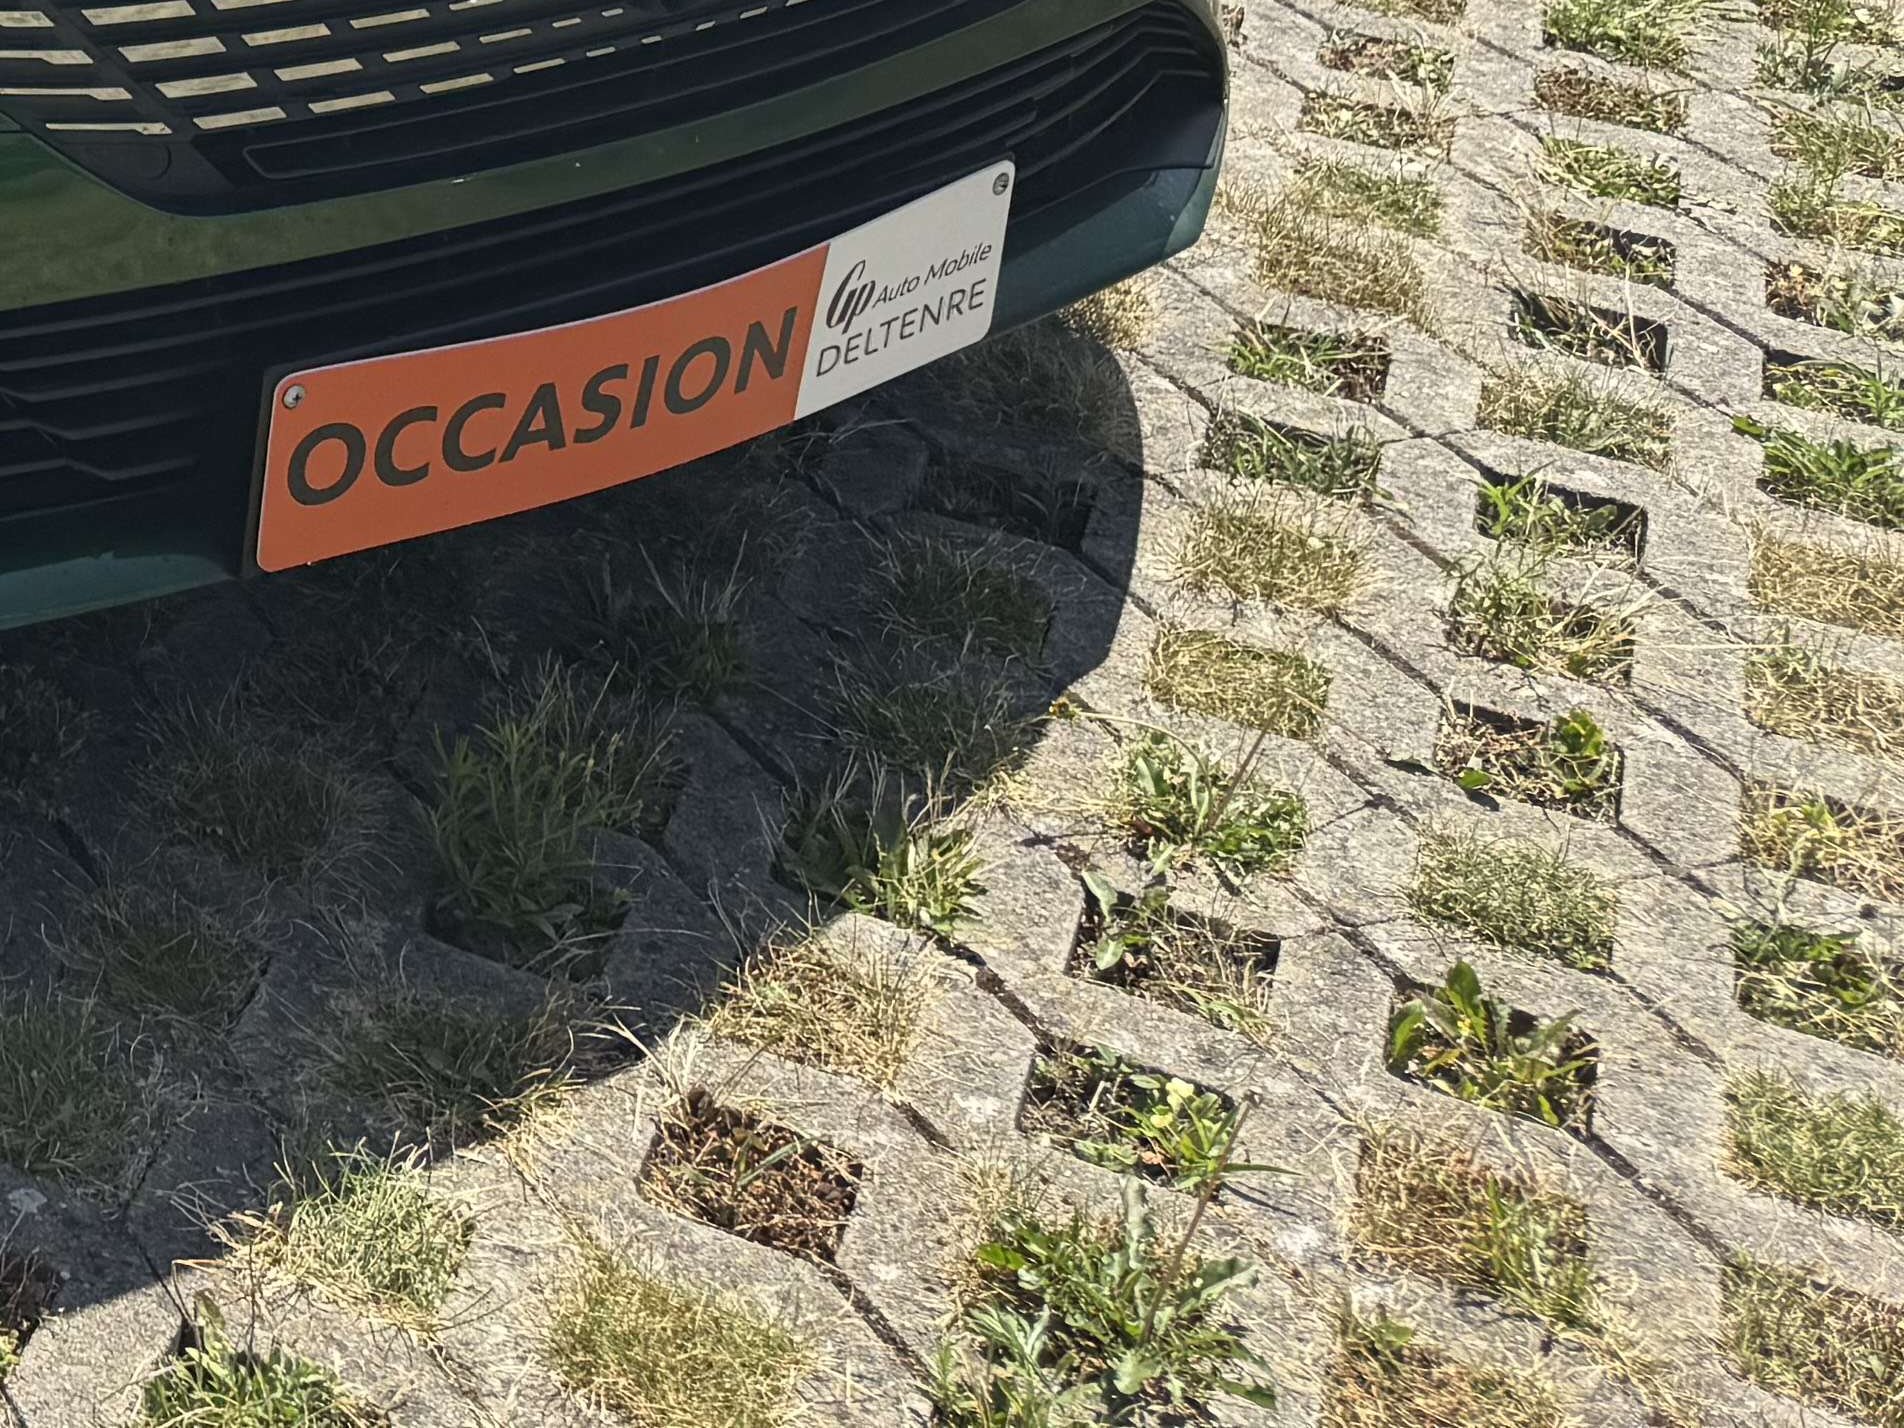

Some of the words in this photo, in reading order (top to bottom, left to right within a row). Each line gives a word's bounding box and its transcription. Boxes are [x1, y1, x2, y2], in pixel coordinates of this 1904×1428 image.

[872, 274, 920, 309] Auto
[923, 242, 992, 285] Mobile
[815, 278, 987, 377] DELTENRE
[286, 305, 799, 507] OCCASION
